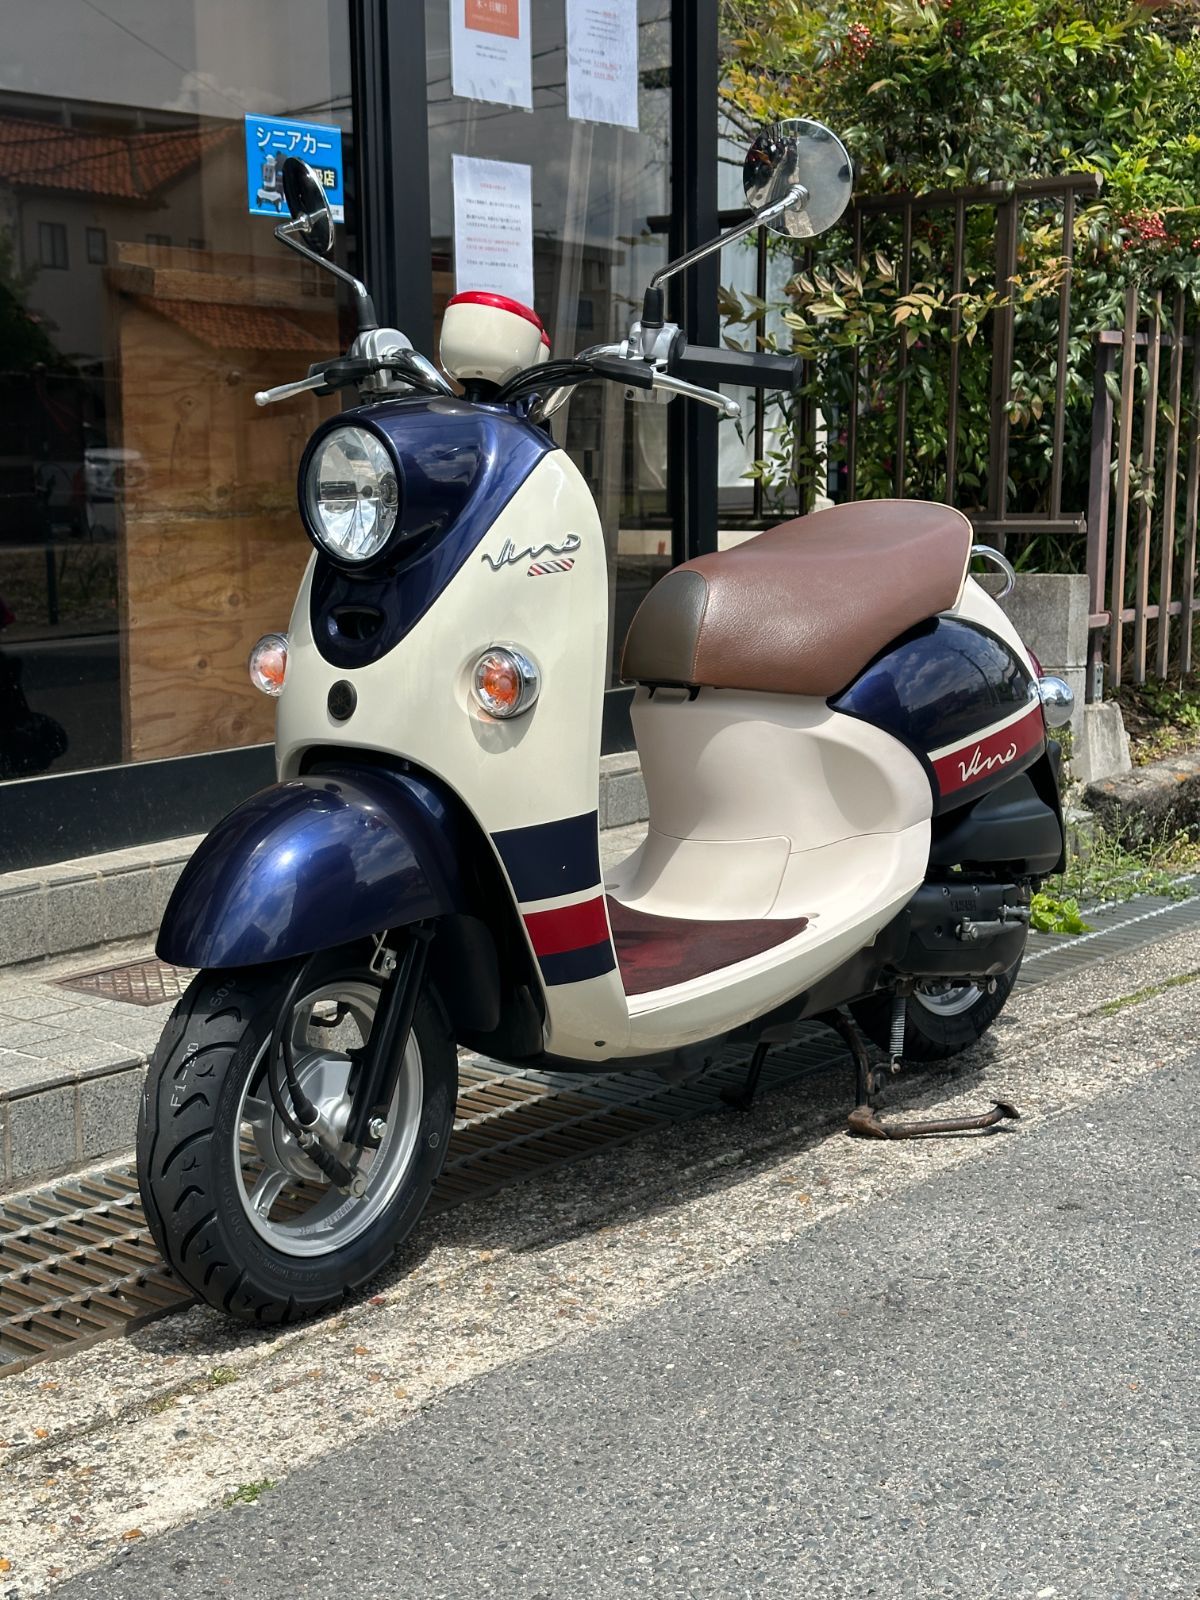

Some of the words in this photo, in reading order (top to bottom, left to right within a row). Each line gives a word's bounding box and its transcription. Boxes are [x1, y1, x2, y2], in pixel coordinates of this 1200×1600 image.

[256, 127, 332, 154] シニアカー
[481, 533, 581, 571] Vino
[958, 743, 1017, 782] Vino
